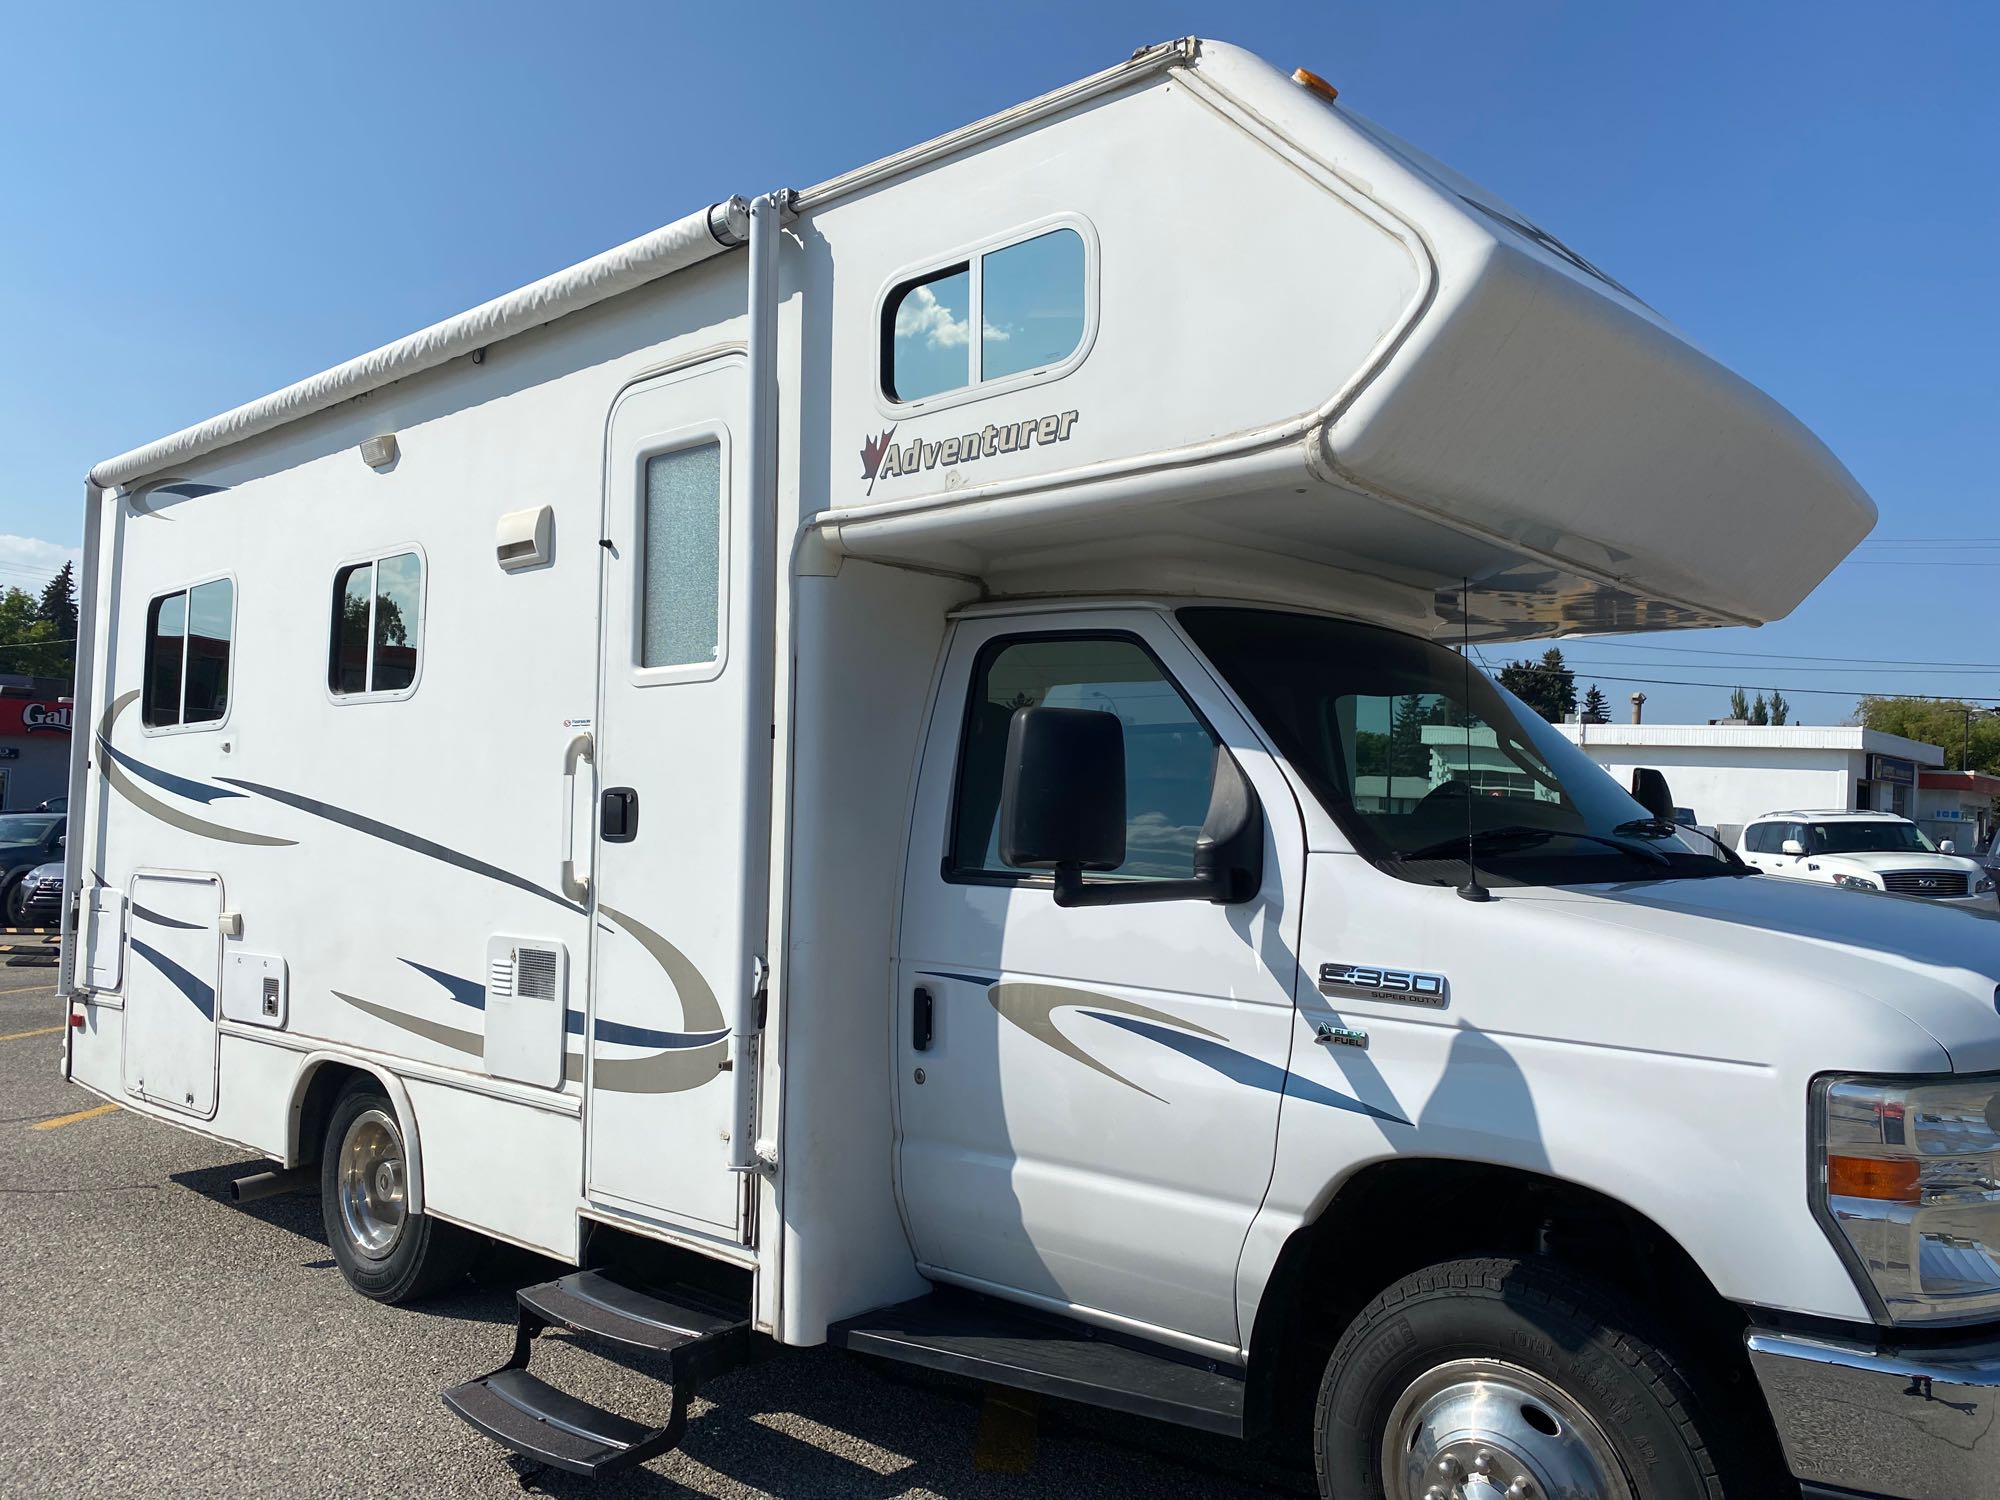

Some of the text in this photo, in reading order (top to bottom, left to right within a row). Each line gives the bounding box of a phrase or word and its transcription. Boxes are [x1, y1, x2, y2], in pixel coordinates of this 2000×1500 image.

[880, 409, 1079, 479] Adventurer
[1371, 991, 1439, 1004] SUPER DUTY
[1335, 1028, 1362, 1039] FLEX
[1334, 1036, 1362, 1047] FUEL
